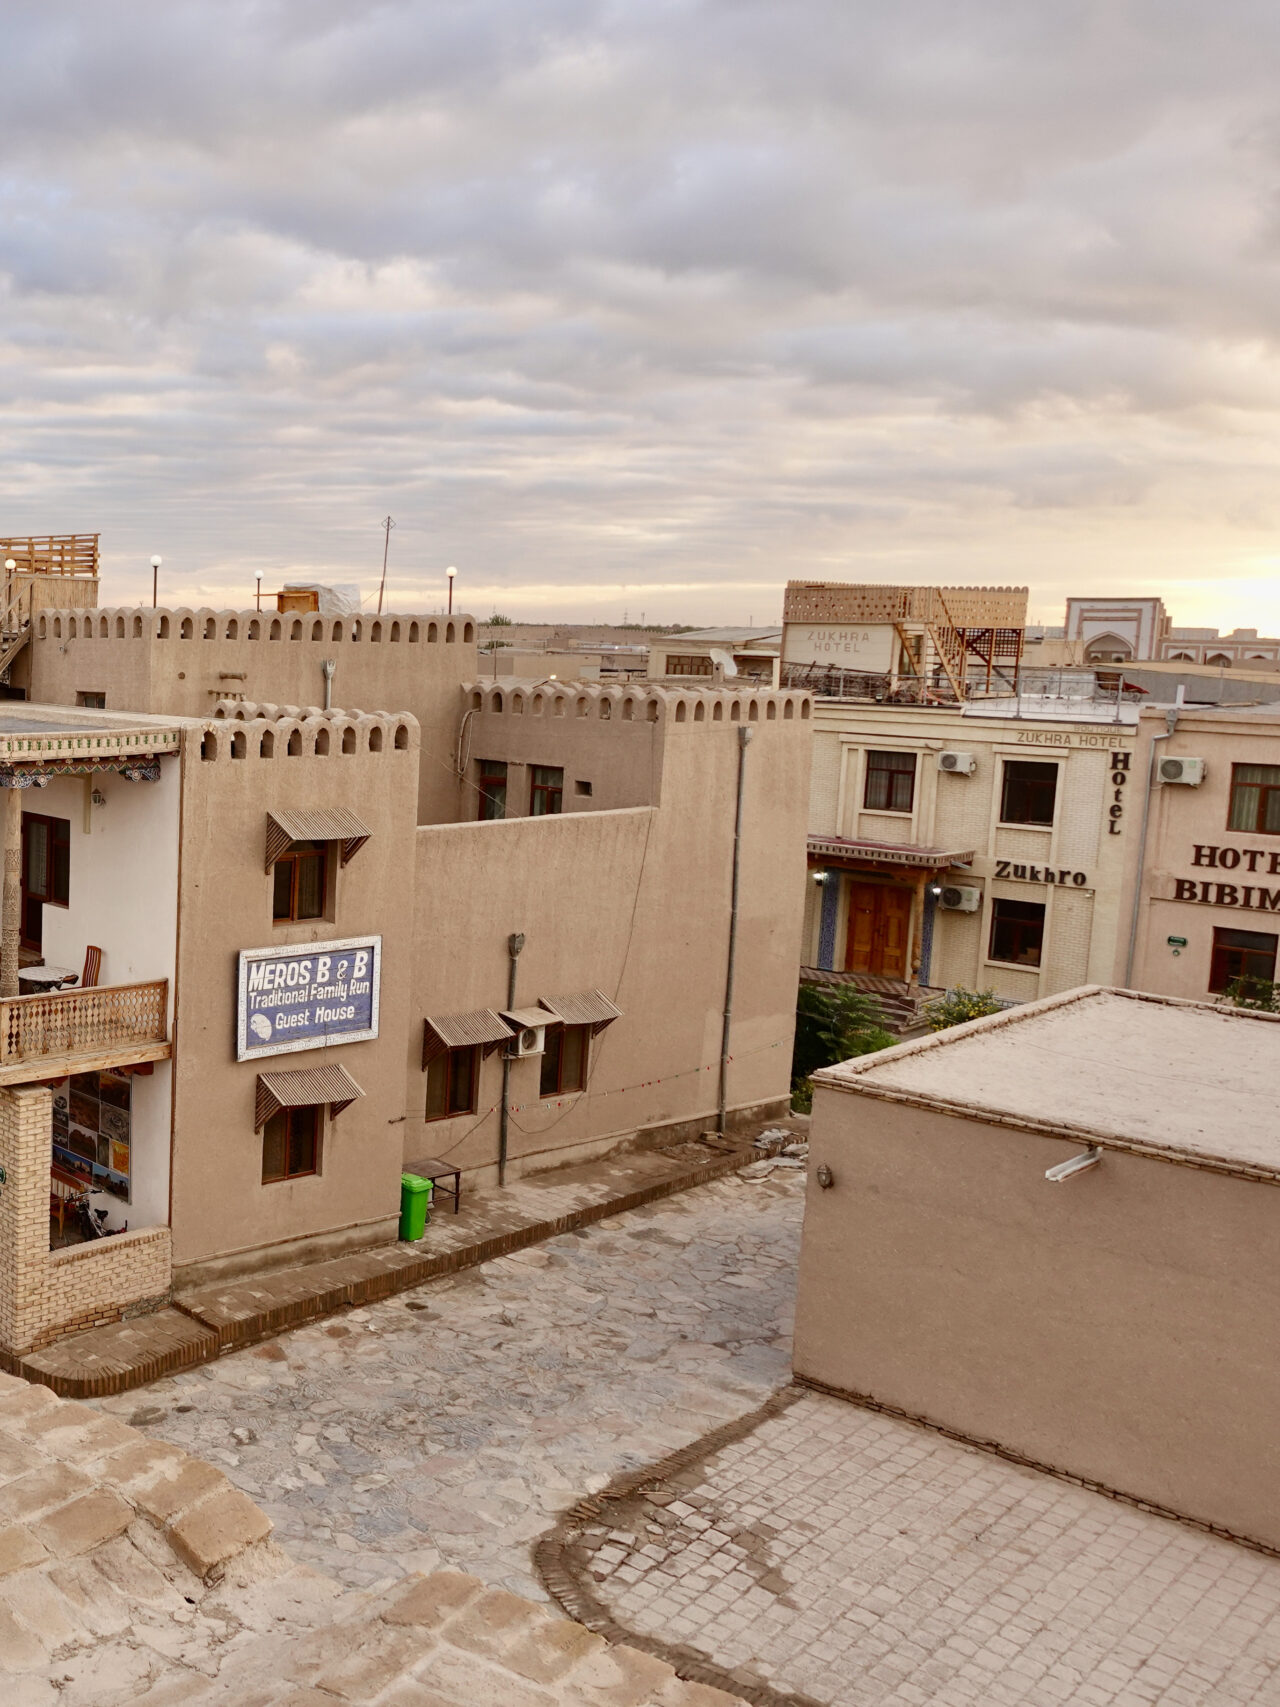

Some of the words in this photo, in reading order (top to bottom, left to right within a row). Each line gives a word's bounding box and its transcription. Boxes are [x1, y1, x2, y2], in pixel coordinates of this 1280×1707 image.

[807, 631, 870, 642] ZUKHRA
[814, 642, 861, 653] HOTEL
[1017, 732, 1072, 745] ZUKHRA
[1079, 735, 1127, 748] HOTEL
[995, 860, 1087, 886] Zukhro
[248, 960, 312, 992] MEROS
[316, 955, 331, 983] B
[336, 959, 349, 980] &
[352, 950, 369, 979] B
[250, 985, 309, 1010] Traditional
[310, 980, 348, 1002] Family
[349, 978, 370, 996] Run
[275, 1008, 310, 1029] Guest
[315, 1005, 355, 1024] House
